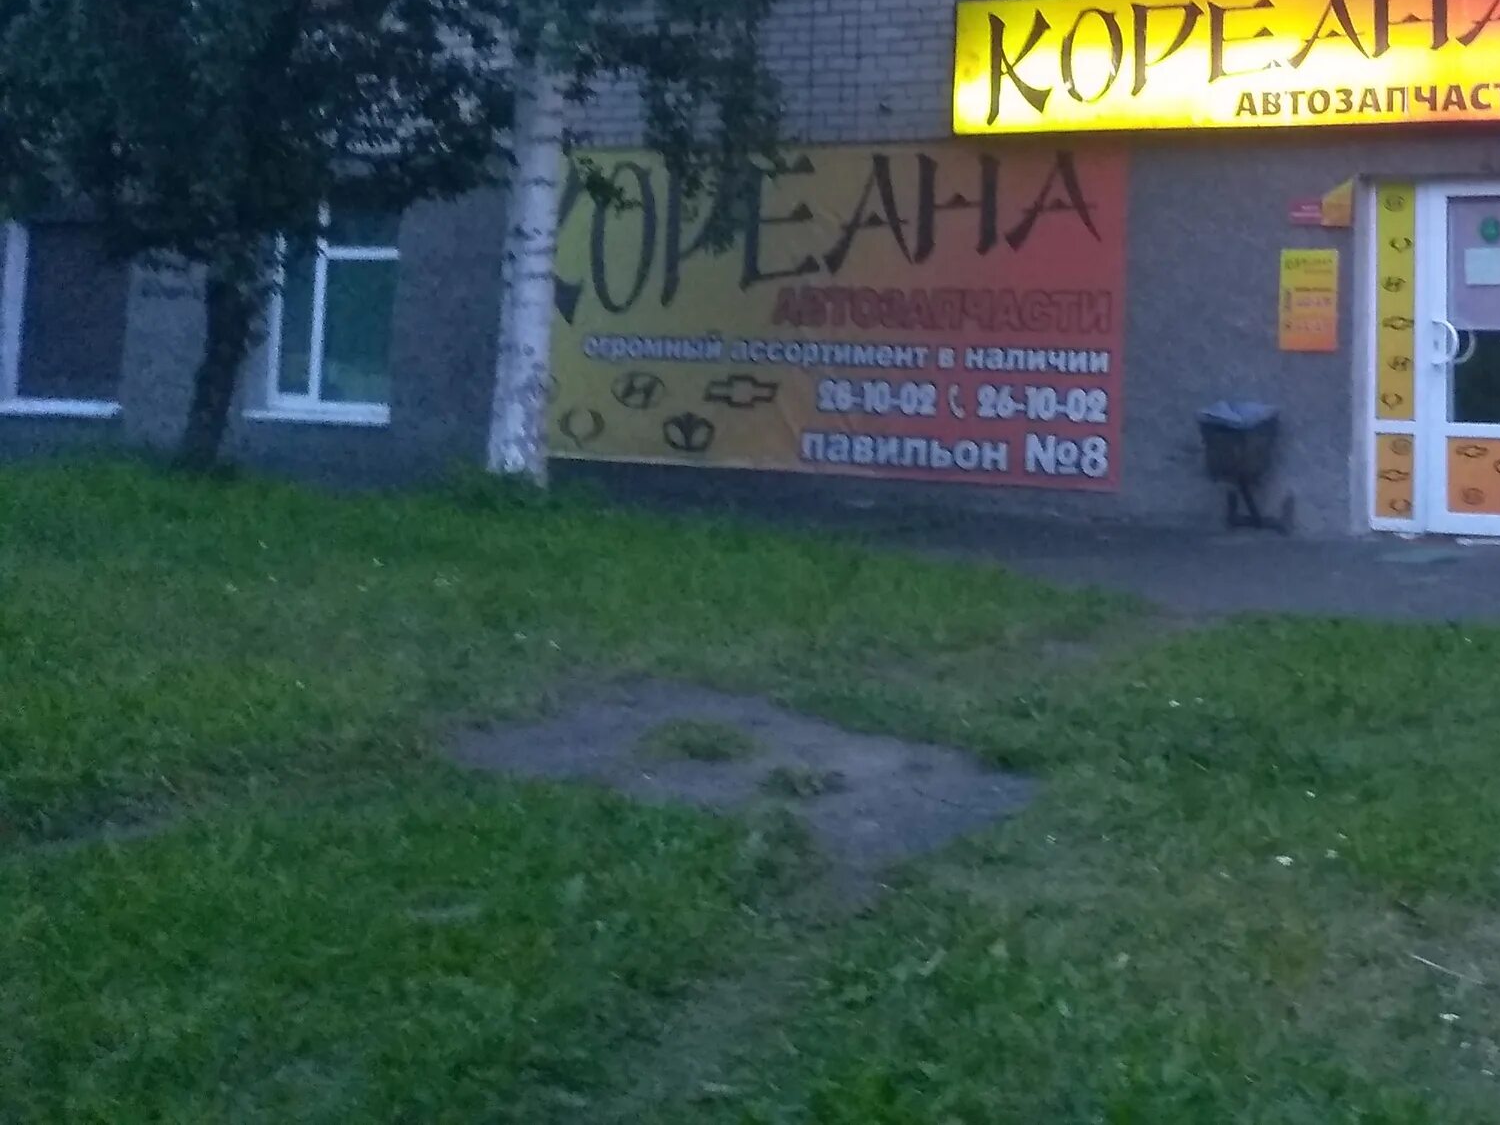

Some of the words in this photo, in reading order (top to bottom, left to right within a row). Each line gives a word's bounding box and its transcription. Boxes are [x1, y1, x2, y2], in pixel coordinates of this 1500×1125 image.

[773, 285, 1113, 333] АВТОЗАПЧАСТИ
[730, 340, 929, 372] ассортимент
[937, 347, 956, 370] в
[964, 348, 1110, 373] наличии
[802, 432, 1009, 473] павильон
[1024, 432, 1110, 477] №8
